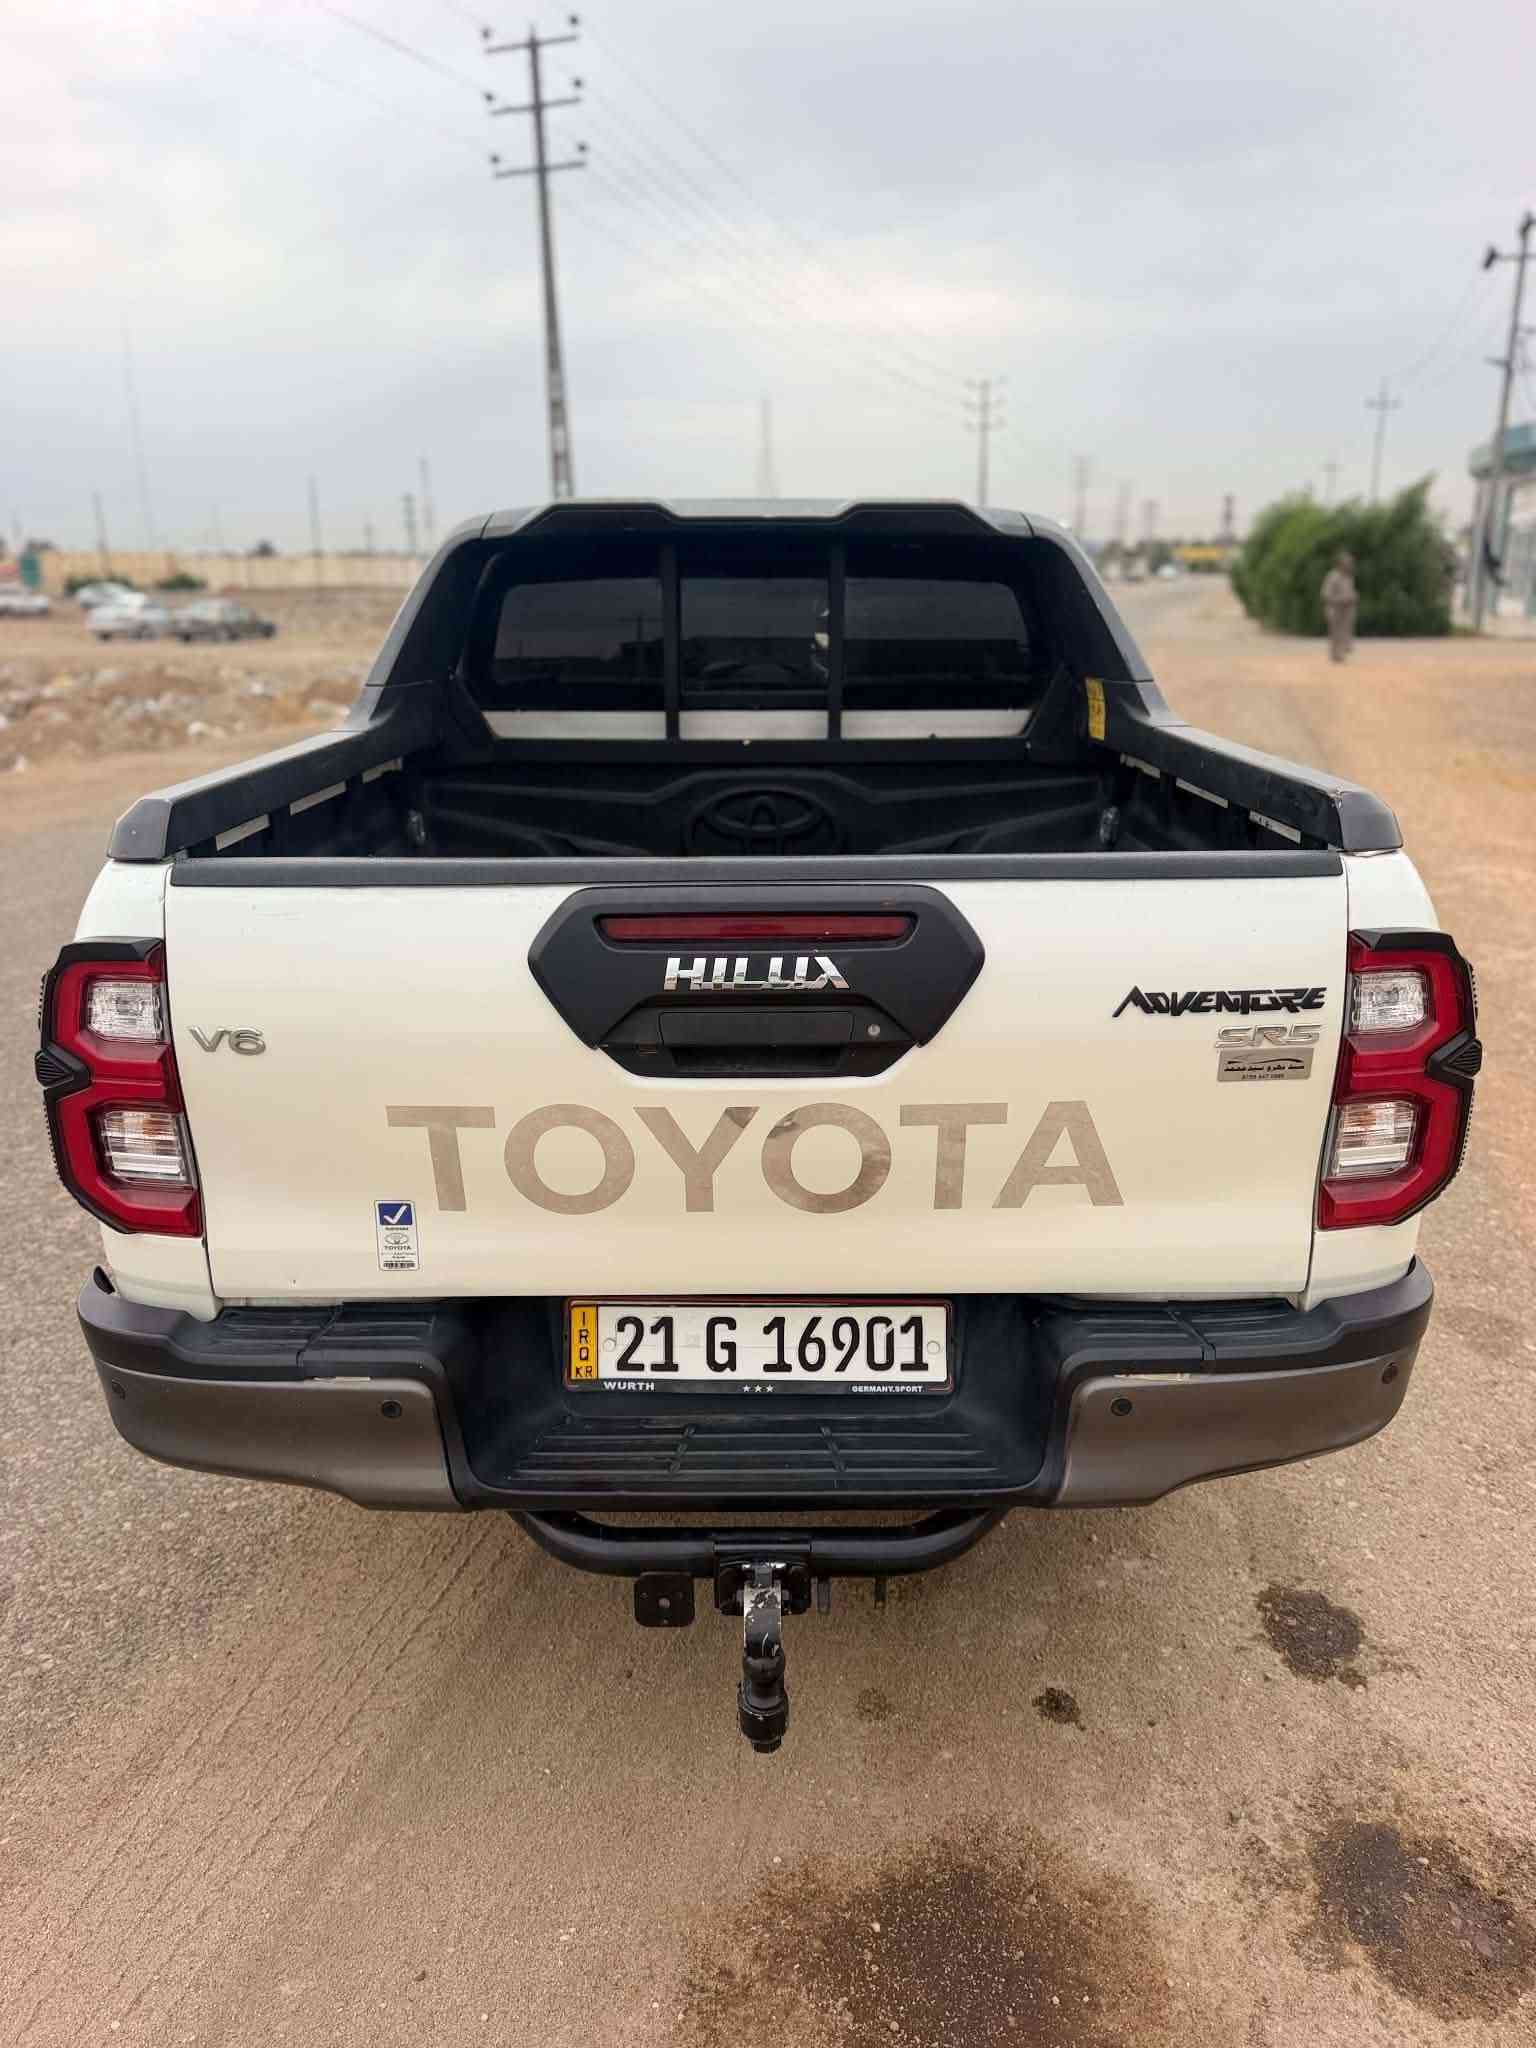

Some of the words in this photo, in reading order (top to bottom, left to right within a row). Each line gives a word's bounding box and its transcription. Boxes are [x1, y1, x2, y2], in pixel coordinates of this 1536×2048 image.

[664, 957, 849, 991] HILUX
[1112, 985, 1328, 1018] ADVENTURE
[188, 1026, 266, 1056] V6
[1214, 1023, 1323, 1049] SR5
[386, 1100, 1125, 1215] TOYOTA
[616, 1316, 679, 1372] 21
[706, 1316, 737, 1373] G
[762, 1315, 929, 1373] 16901
[575, 1365, 593, 1378] KR
[603, 1381, 655, 1391] WURTH
